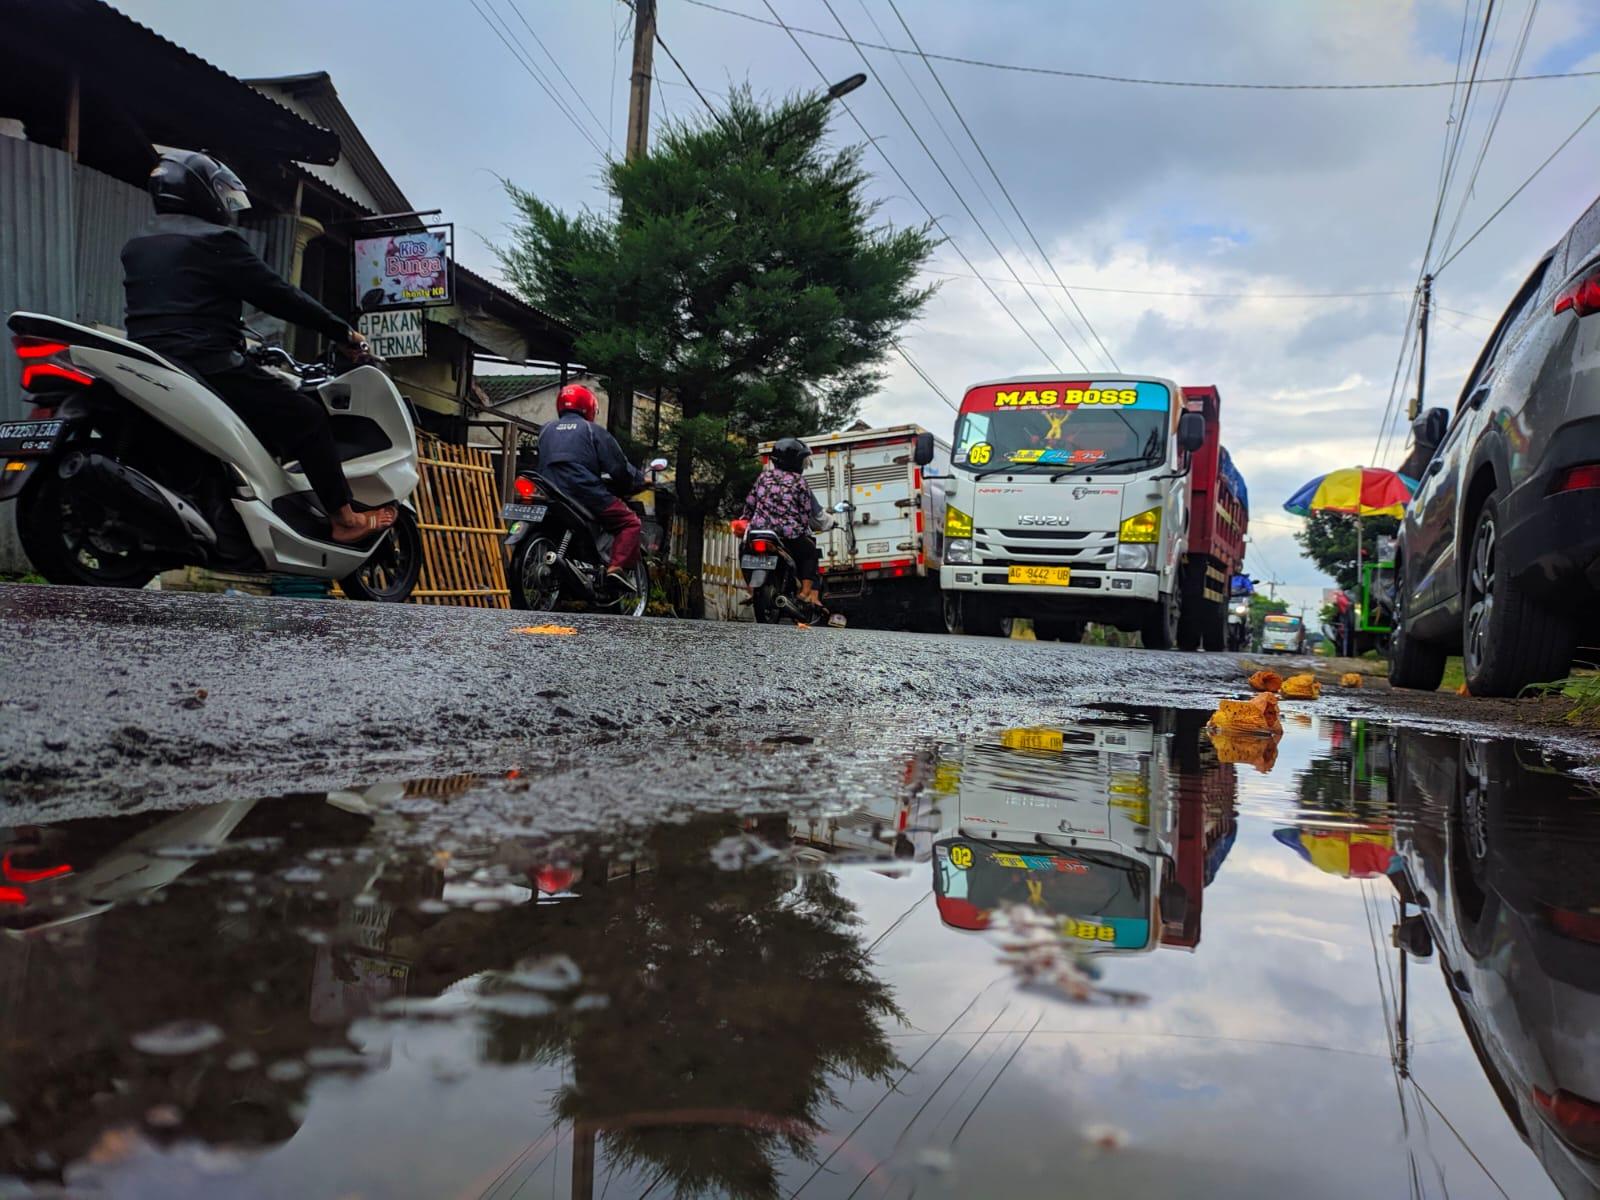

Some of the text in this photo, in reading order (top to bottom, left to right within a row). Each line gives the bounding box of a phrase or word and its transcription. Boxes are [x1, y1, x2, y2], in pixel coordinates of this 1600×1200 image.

[400, 241, 427, 257] Kios
[386, 256, 441, 277] Bunga
[371, 311, 422, 335] PAKAN
[370, 335, 421, 357] TERNAK
[995, 389, 1138, 406] MAS BOSS
[969, 445, 991, 464] 05
[1017, 514, 1070, 526] ISUZU
[1010, 567, 1069, 581] AG 9442 UB
